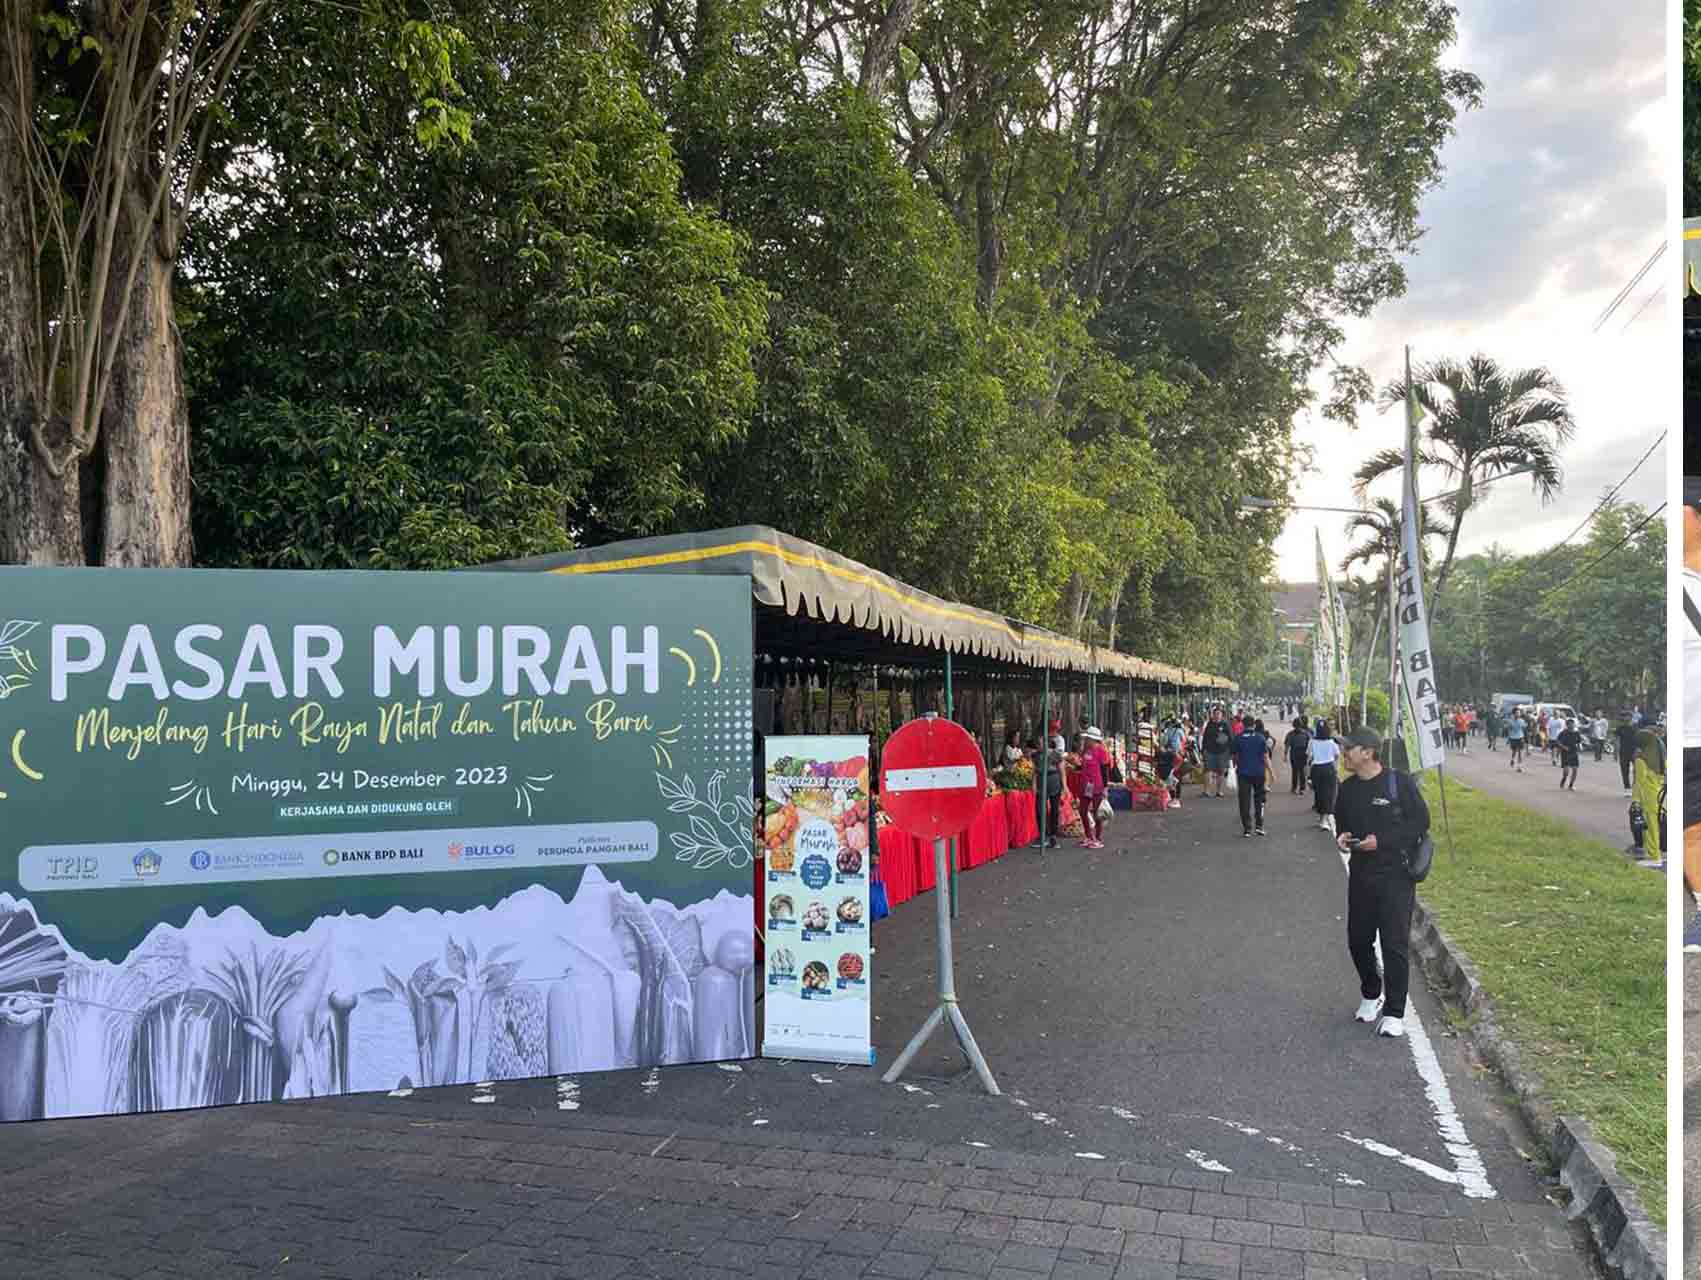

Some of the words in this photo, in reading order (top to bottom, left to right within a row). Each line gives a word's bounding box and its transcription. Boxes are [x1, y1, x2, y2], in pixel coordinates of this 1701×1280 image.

[51, 623, 345, 701] PASAR
[373, 624, 659, 697] MURAH
[75, 706, 209, 760] Menjelang
[221, 702, 282, 752] Hari
[289, 702, 368, 753] Raya
[378, 700, 443, 744] Natal
[450, 701, 495, 736] dan
[502, 699, 577, 742] Tahun
[585, 699, 653, 741] Baru
[231, 772, 307, 798] Minggu,
[316, 771, 344, 789] 24
[353, 770, 446, 789] Desember
[455, 766, 508, 785] 2023
[280, 803, 344, 817] KERJASAMA
[347, 803, 368, 815] DAN
[371, 801, 424, 814] DIDUKUNG
[425, 800, 452, 812] OLEH
[341, 851, 371, 863] BANK
[374, 850, 397, 861] BPD
[400, 848, 424, 860] BALI
[465, 843, 514, 857] BULOG
[537, 846, 584, 857] PERUMDA
[586, 844, 625, 855] PANGAN
[628, 842, 649, 852] BALI
